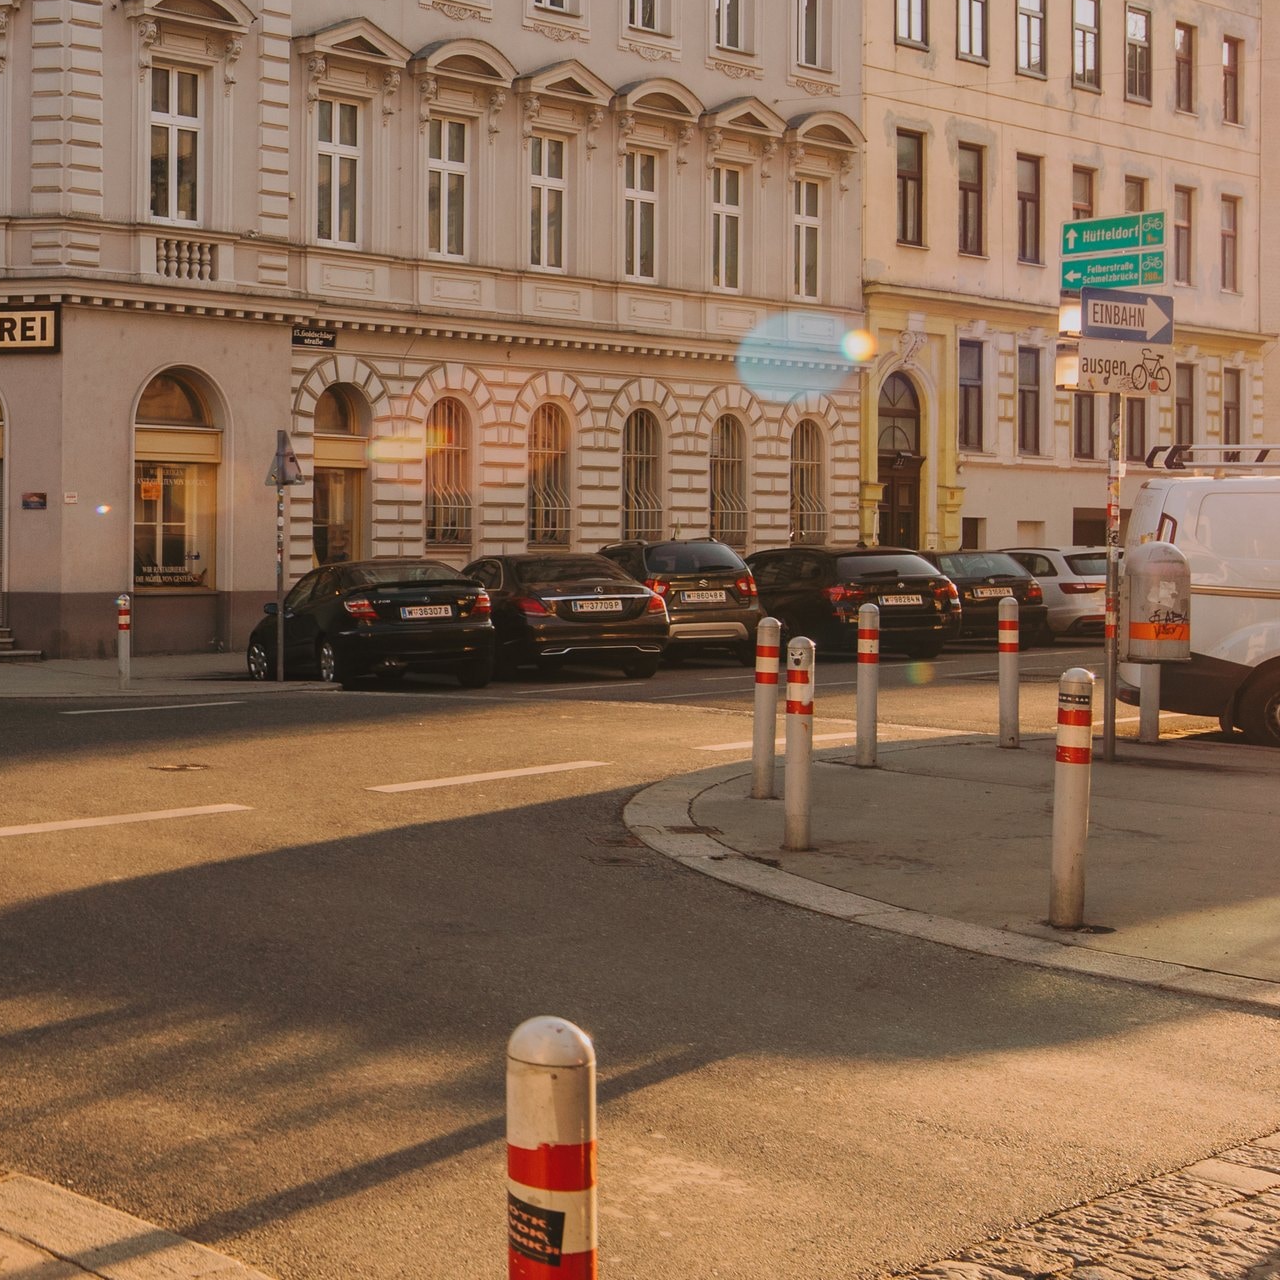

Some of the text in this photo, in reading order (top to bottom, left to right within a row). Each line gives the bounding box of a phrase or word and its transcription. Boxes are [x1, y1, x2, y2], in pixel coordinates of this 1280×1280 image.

[1083, 225, 1139, 242] Hütteldorf
[1087, 262, 1134, 274] Felberstraße
[1082, 271, 1139, 284] Schmelzbrücke
[1092, 303, 1145, 328] EINBAHN
[1082, 357, 1130, 380] ausgen.
